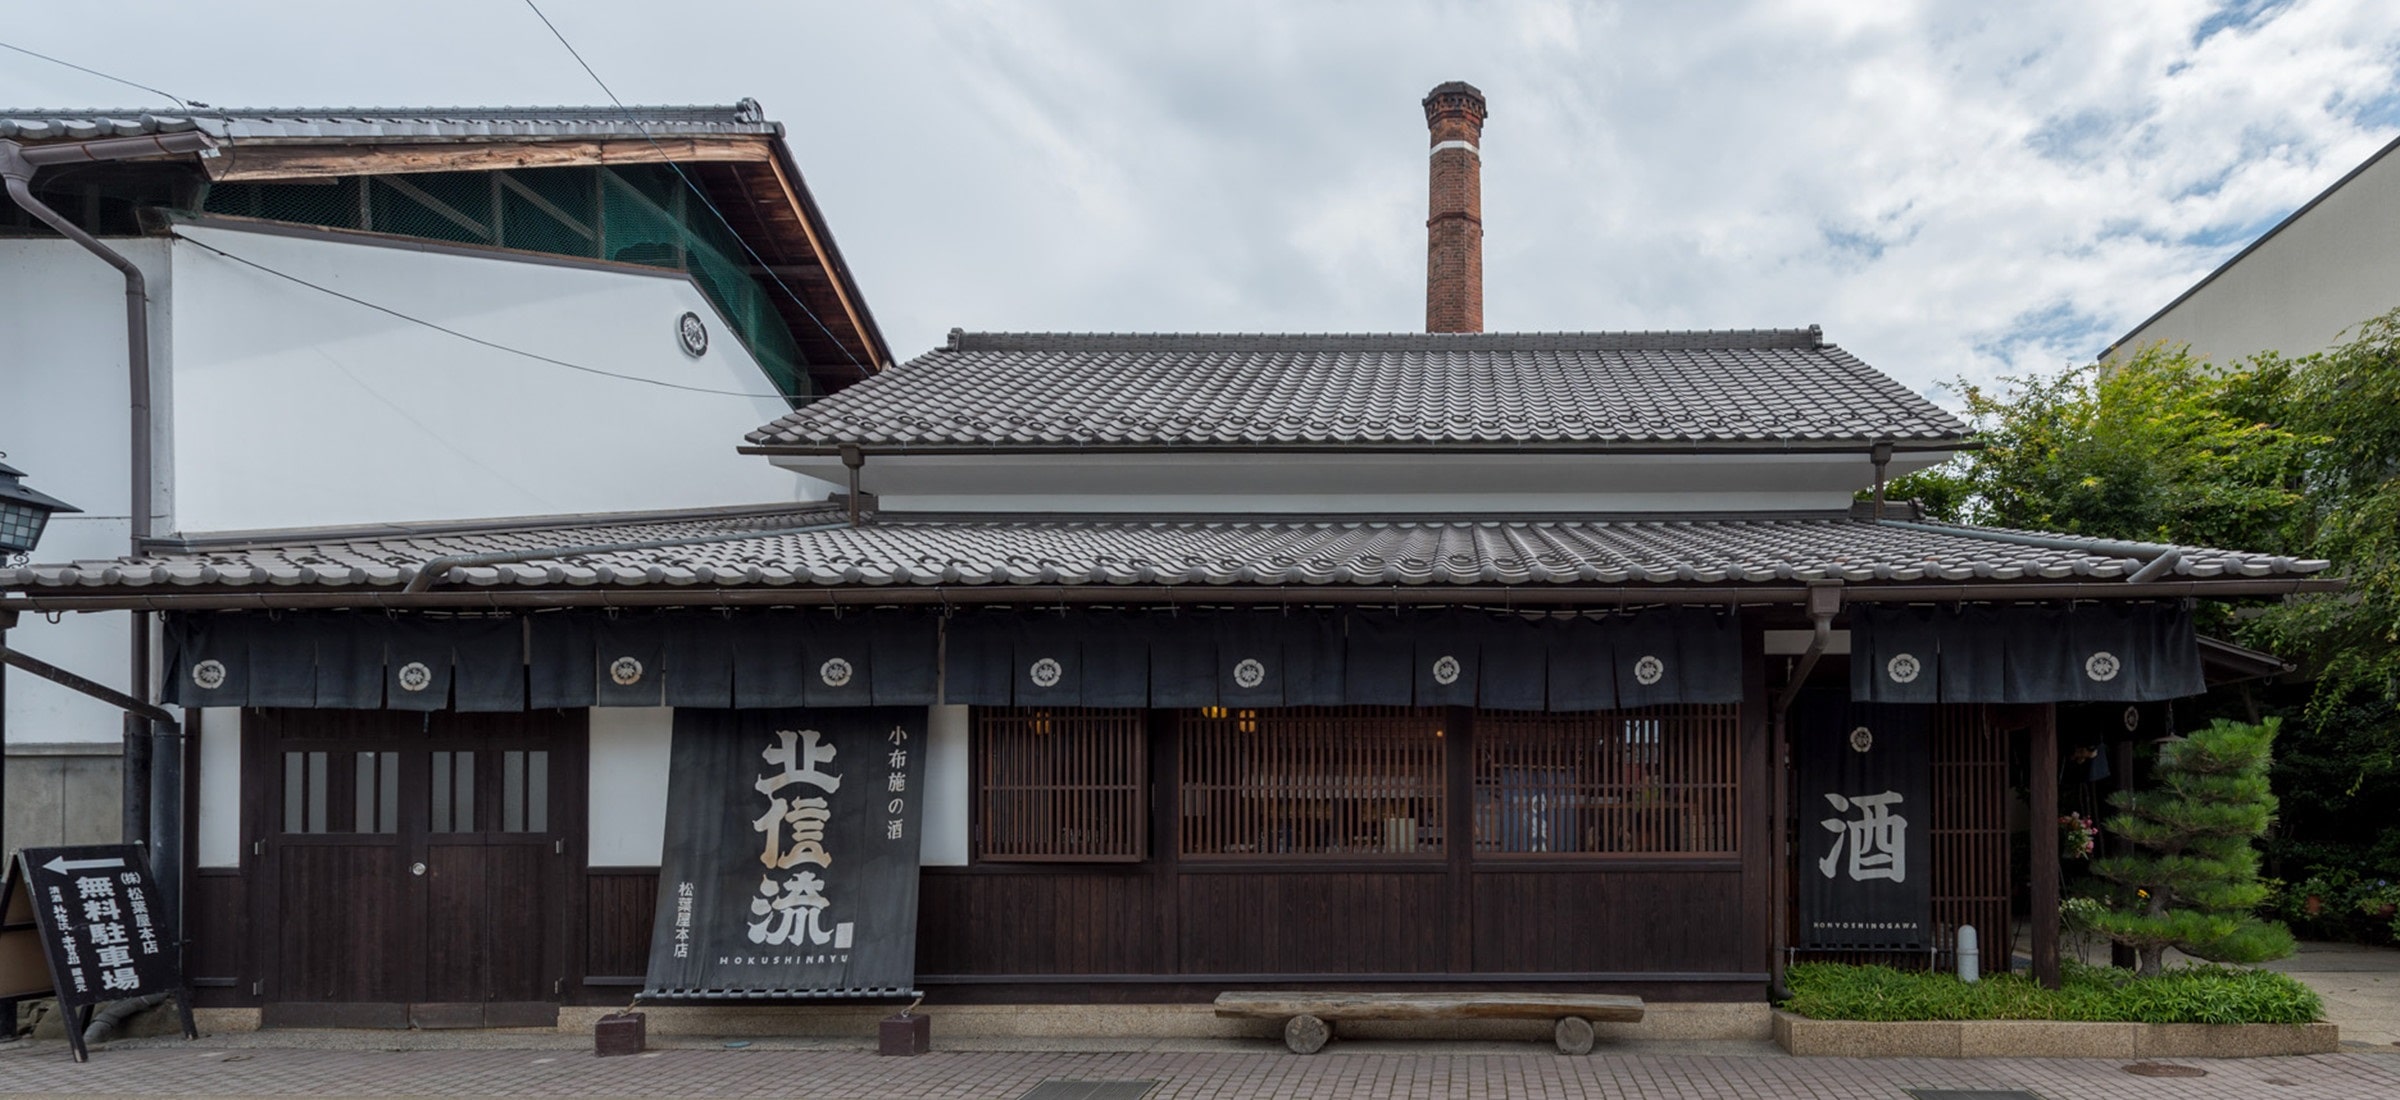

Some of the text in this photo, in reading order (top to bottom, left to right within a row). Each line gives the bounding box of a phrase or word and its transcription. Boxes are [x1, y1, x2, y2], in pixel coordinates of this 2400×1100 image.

[886, 725, 908, 840] 小布施の酒
[747, 729, 843, 947] 北信流
[1818, 790, 1909, 884] 酒
[75, 876, 140, 991] 無料駐車場
[673, 881, 695, 958] 松葉屋本店
[719, 954, 849, 965] HOKUSHINRYU
